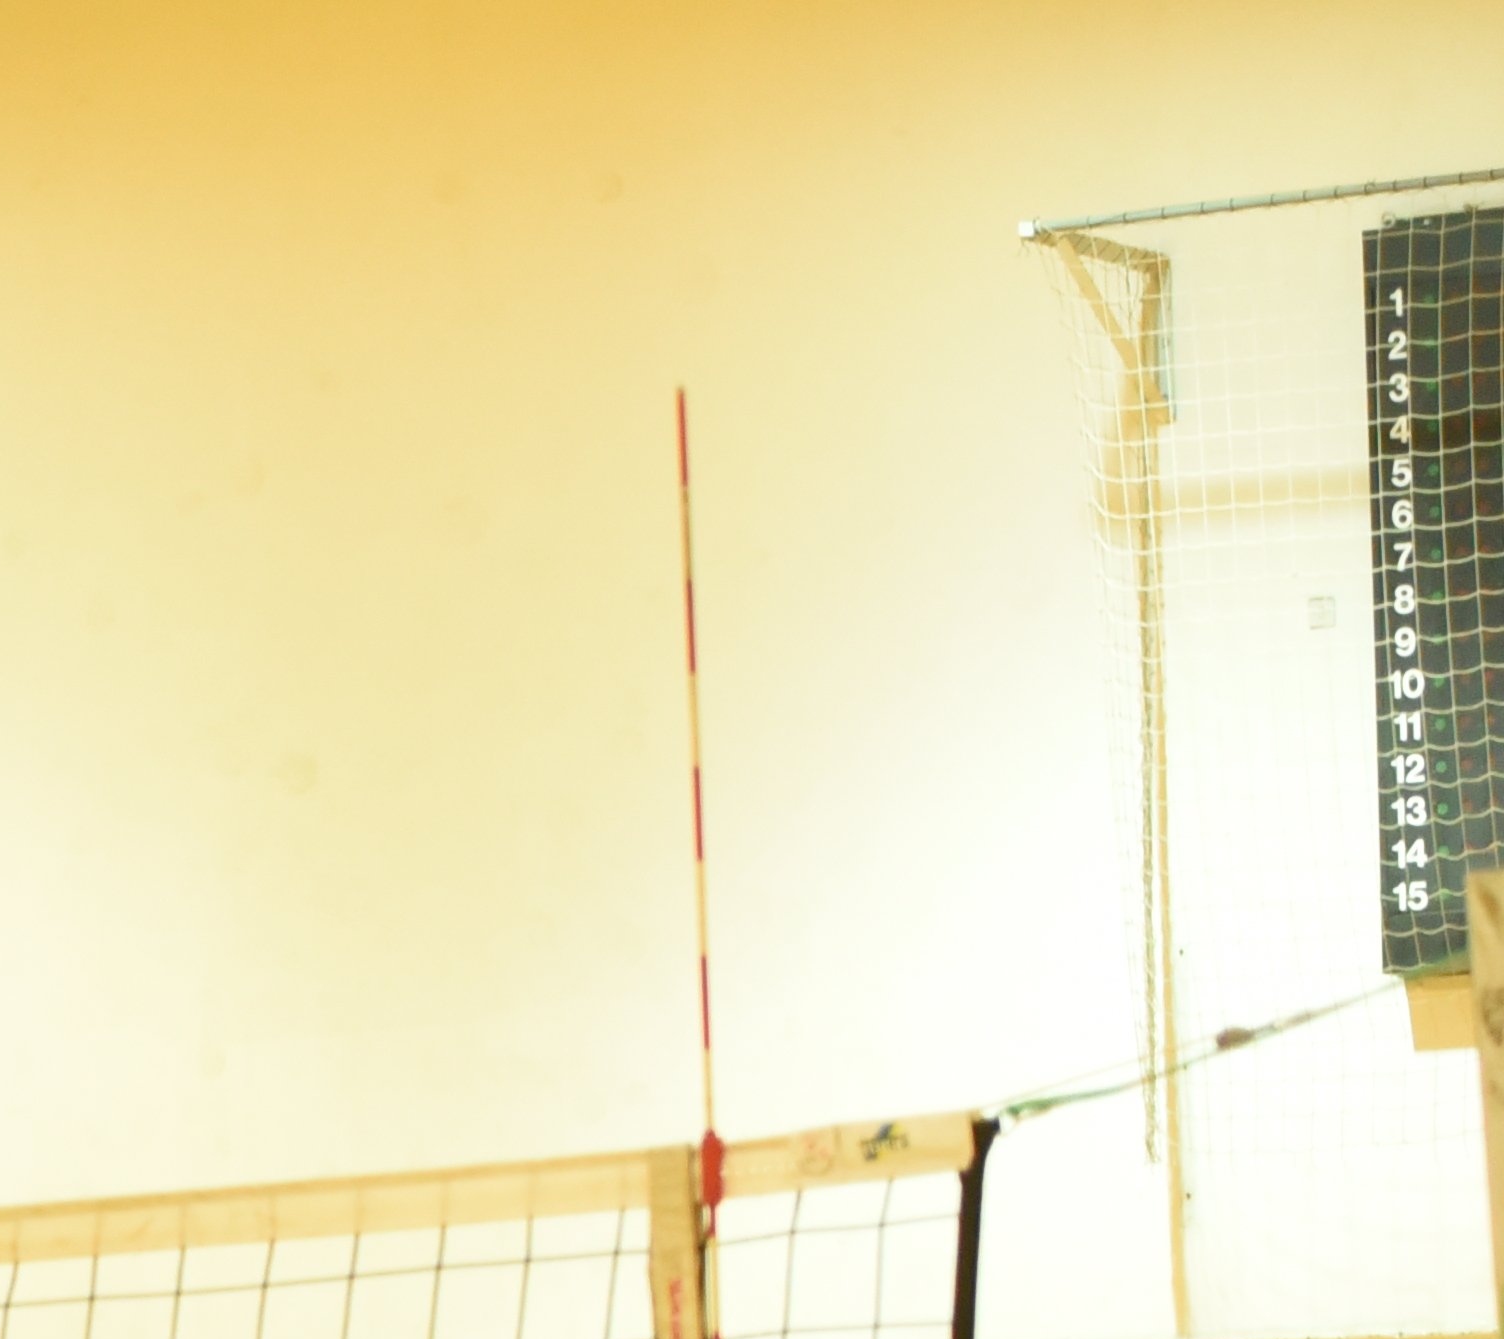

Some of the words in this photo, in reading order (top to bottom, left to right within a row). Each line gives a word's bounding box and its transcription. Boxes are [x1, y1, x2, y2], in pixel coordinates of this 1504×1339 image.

[1389, 287, 1403, 318] 1
[1388, 330, 1407, 361] 2
[1389, 373, 1409, 403] 3
[1390, 415, 1410, 444] 4
[1391, 458, 1412, 488] 5
[1392, 499, 1413, 530] 6
[1393, 542, 1413, 572] 7
[1393, 584, 1415, 615] 8
[1394, 626, 1416, 657] 9
[1390, 668, 1425, 699] 10
[1393, 711, 1422, 742] 11
[1391, 753, 1426, 784] 12
[1391, 795, 1427, 827] 13
[1391, 838, 1428, 870] 14
[1392, 880, 1429, 912] 15
